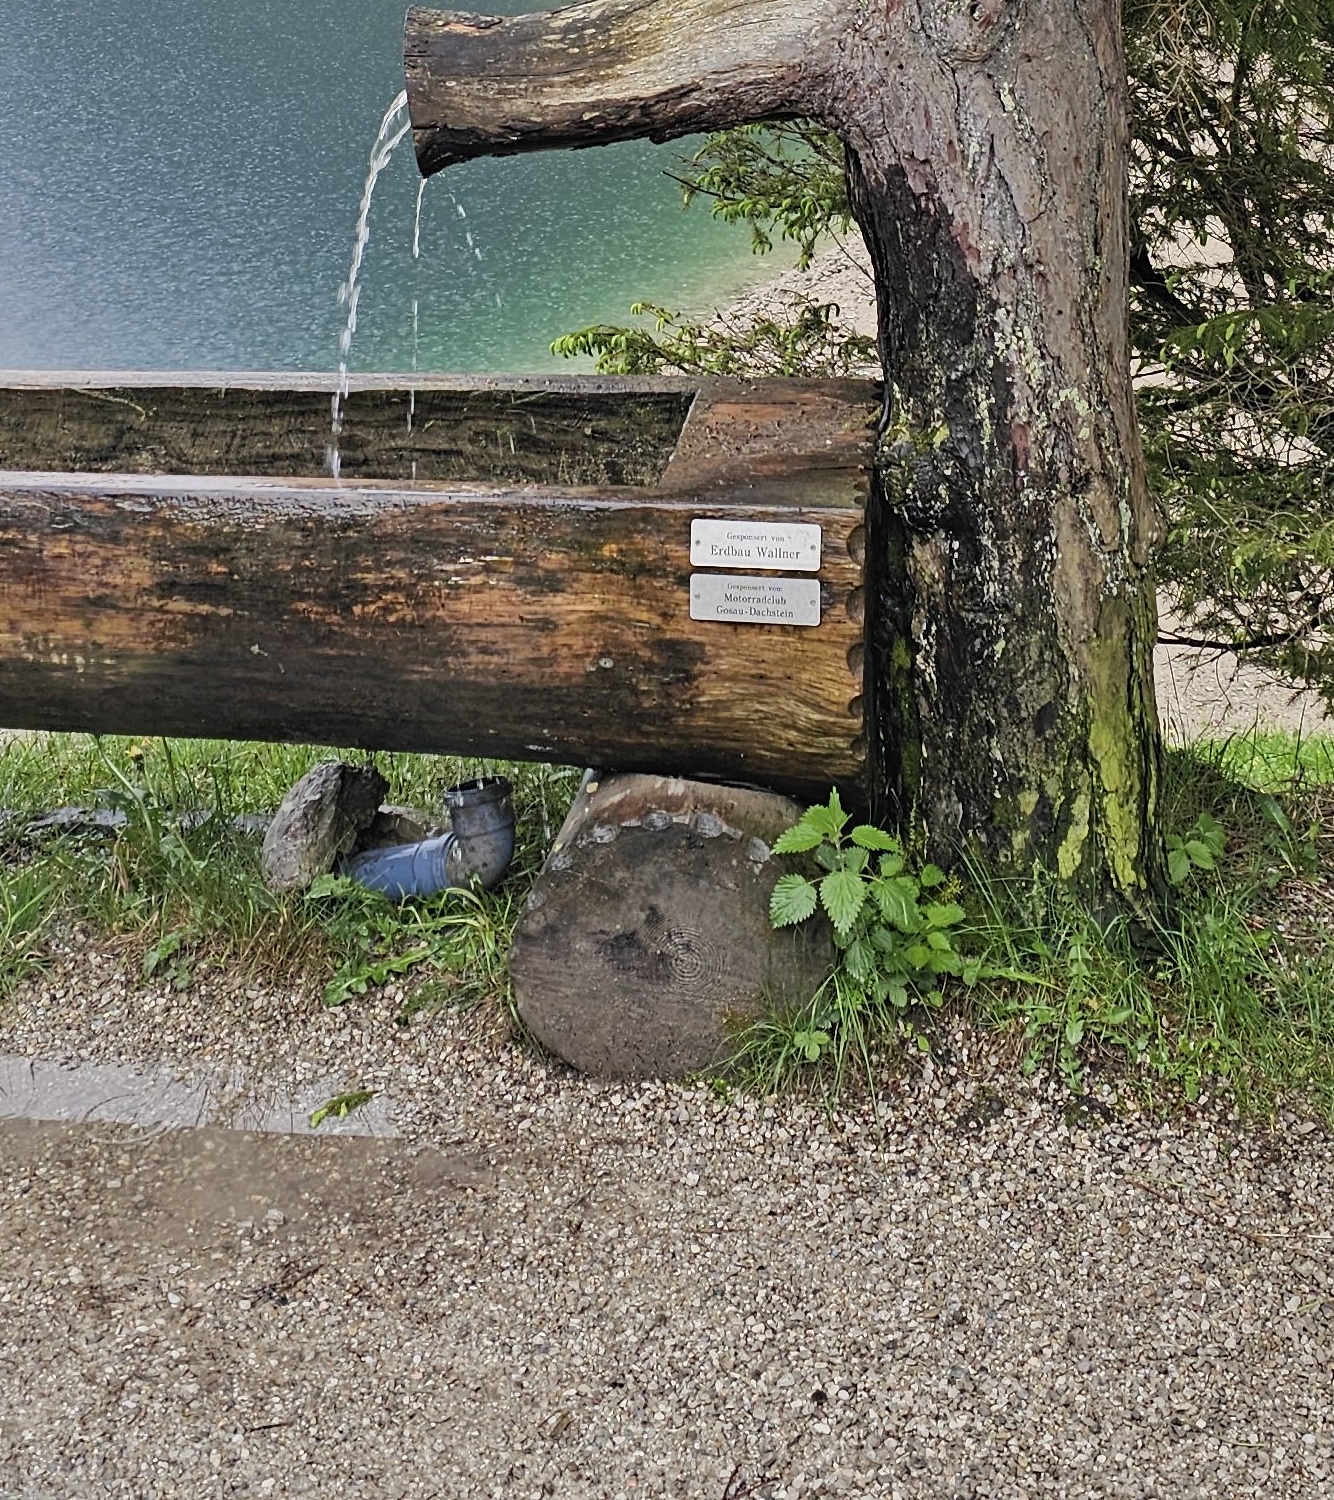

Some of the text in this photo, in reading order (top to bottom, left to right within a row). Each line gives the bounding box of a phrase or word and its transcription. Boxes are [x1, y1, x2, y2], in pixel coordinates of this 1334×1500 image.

[727, 532, 768, 542] Gesponsert
[711, 545, 801, 559] Erdbau Wallner
[728, 583, 765, 591] Gesponsert
[724, 593, 787, 605] Motorradclub
[717, 606, 794, 618] Gosau-Dachstein
